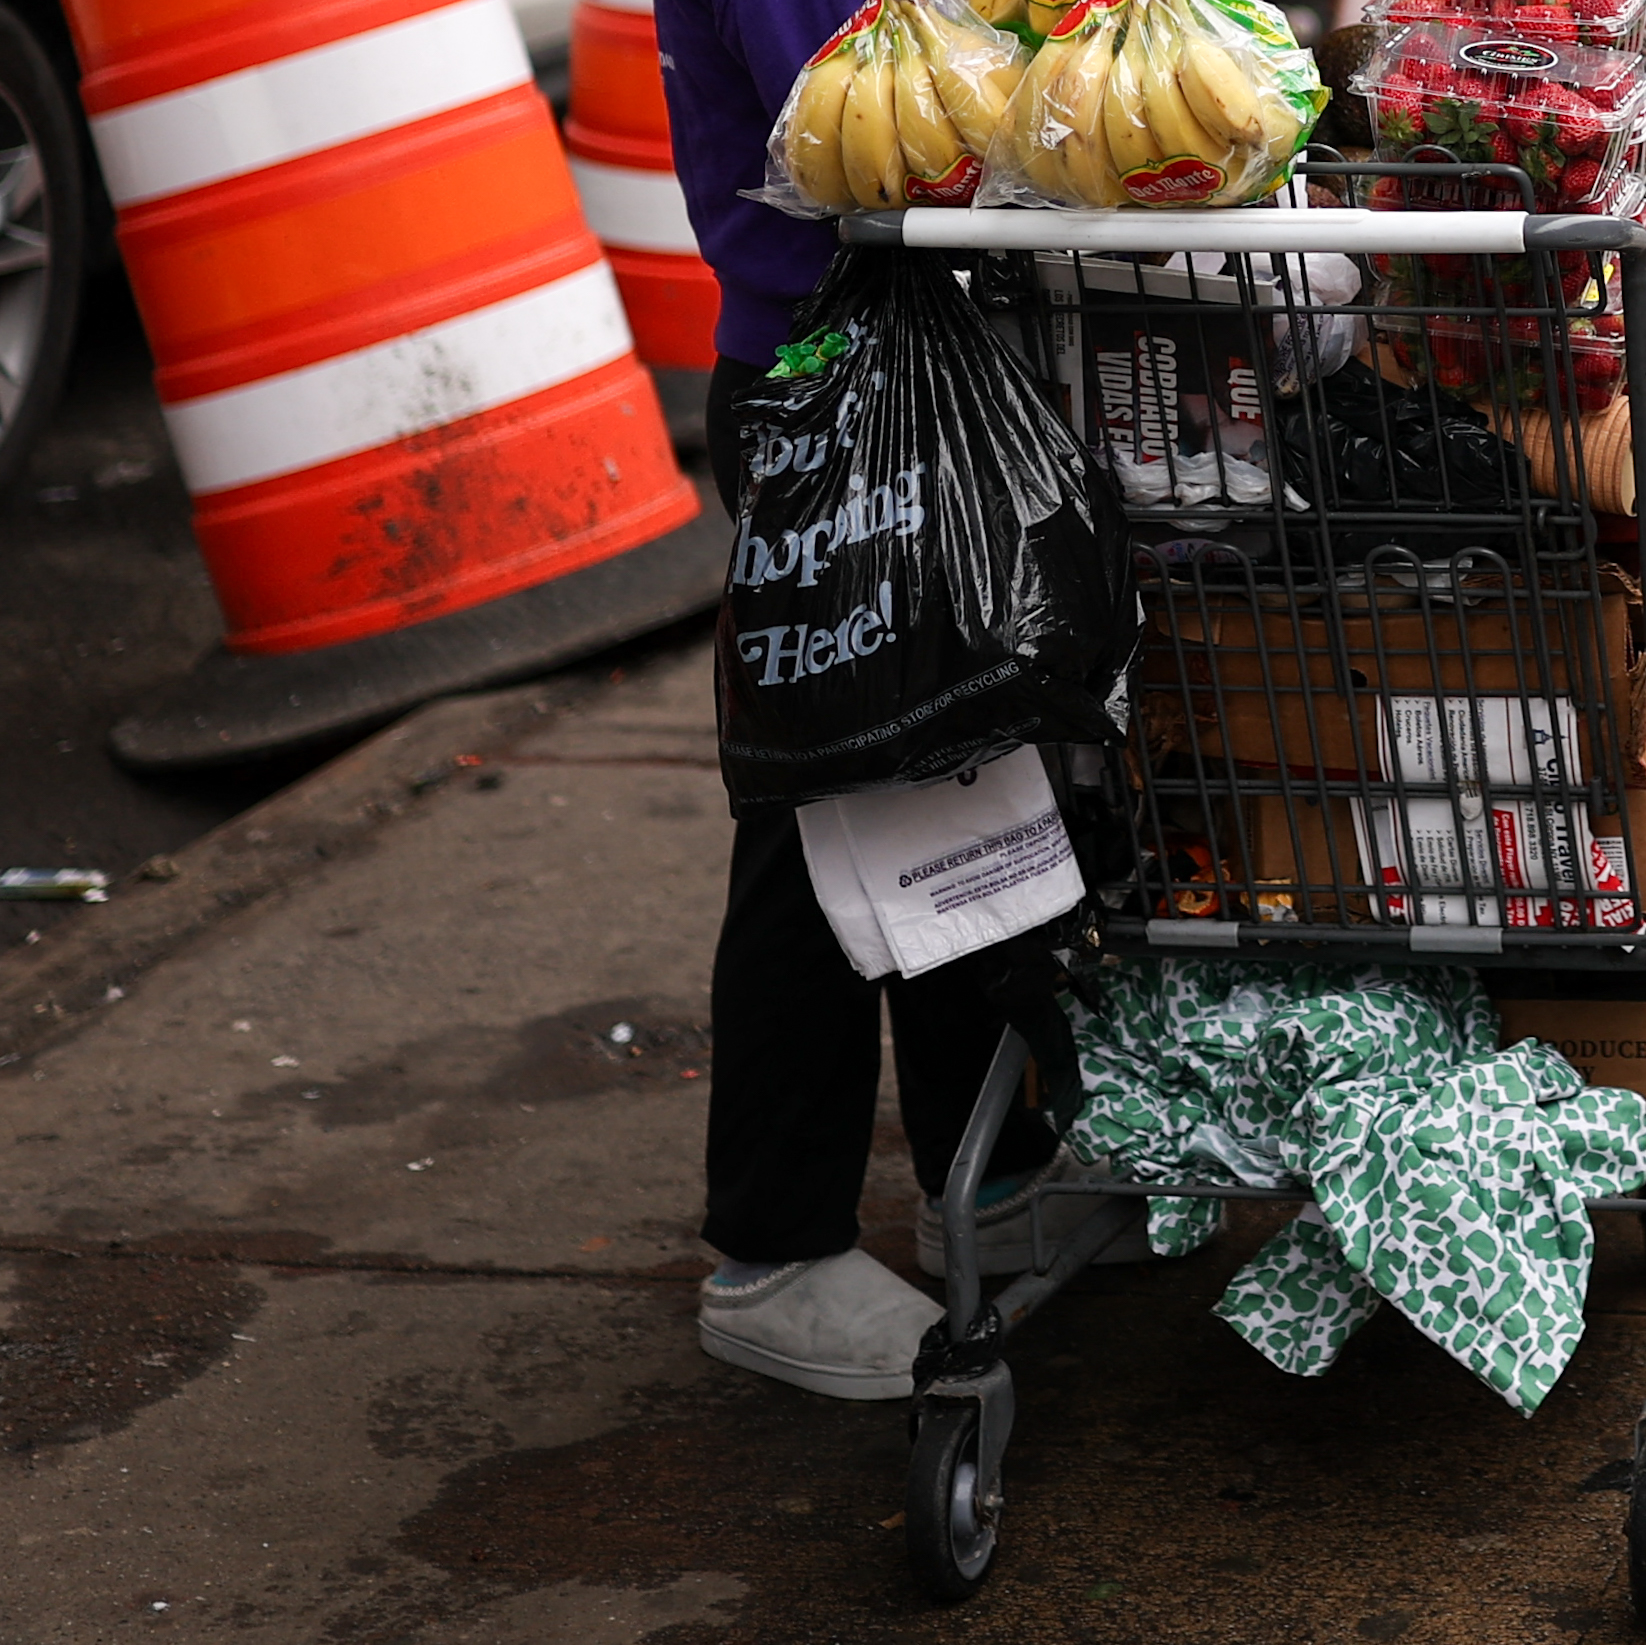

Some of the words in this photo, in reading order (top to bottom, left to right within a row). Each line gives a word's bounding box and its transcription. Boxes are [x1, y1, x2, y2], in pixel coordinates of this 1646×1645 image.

[1128, 182, 1163, 198] Del
[1155, 168, 1215, 192] Monte
[1053, 289, 1065, 303] LOS
[1055, 312, 1065, 343] ECRETOS
[1096, 351, 1134, 422] VIDAS
[730, 462, 927, 589] hopping
[736, 580, 897, 686] Here!
[722, 741, 755, 758] PLEASE
[792, 750, 808, 760] TO
[816, 723, 902, 757] PARTICIPATING
[900, 703, 934, 728] STORE
[934, 692, 956, 712] FOR
[953, 661, 1020, 697] RECYCLING
[1414, 709, 1422, 738] Boletos
[1423, 701, 1433, 735] Paquetes
[1501, 813, 1511, 829] Con
[912, 862, 947, 881] PLEASE
[947, 848, 982, 867] RETURN
[982, 840, 1003, 855] THIS
[1003, 831, 1024, 846] BAG
[1024, 826, 1037, 838] TO
[1447, 836, 1455, 858] Cartas
[1475, 829, 1485, 859] Servicios
[1504, 830, 1513, 847] este
[1556, 824, 1576, 883] Travel
